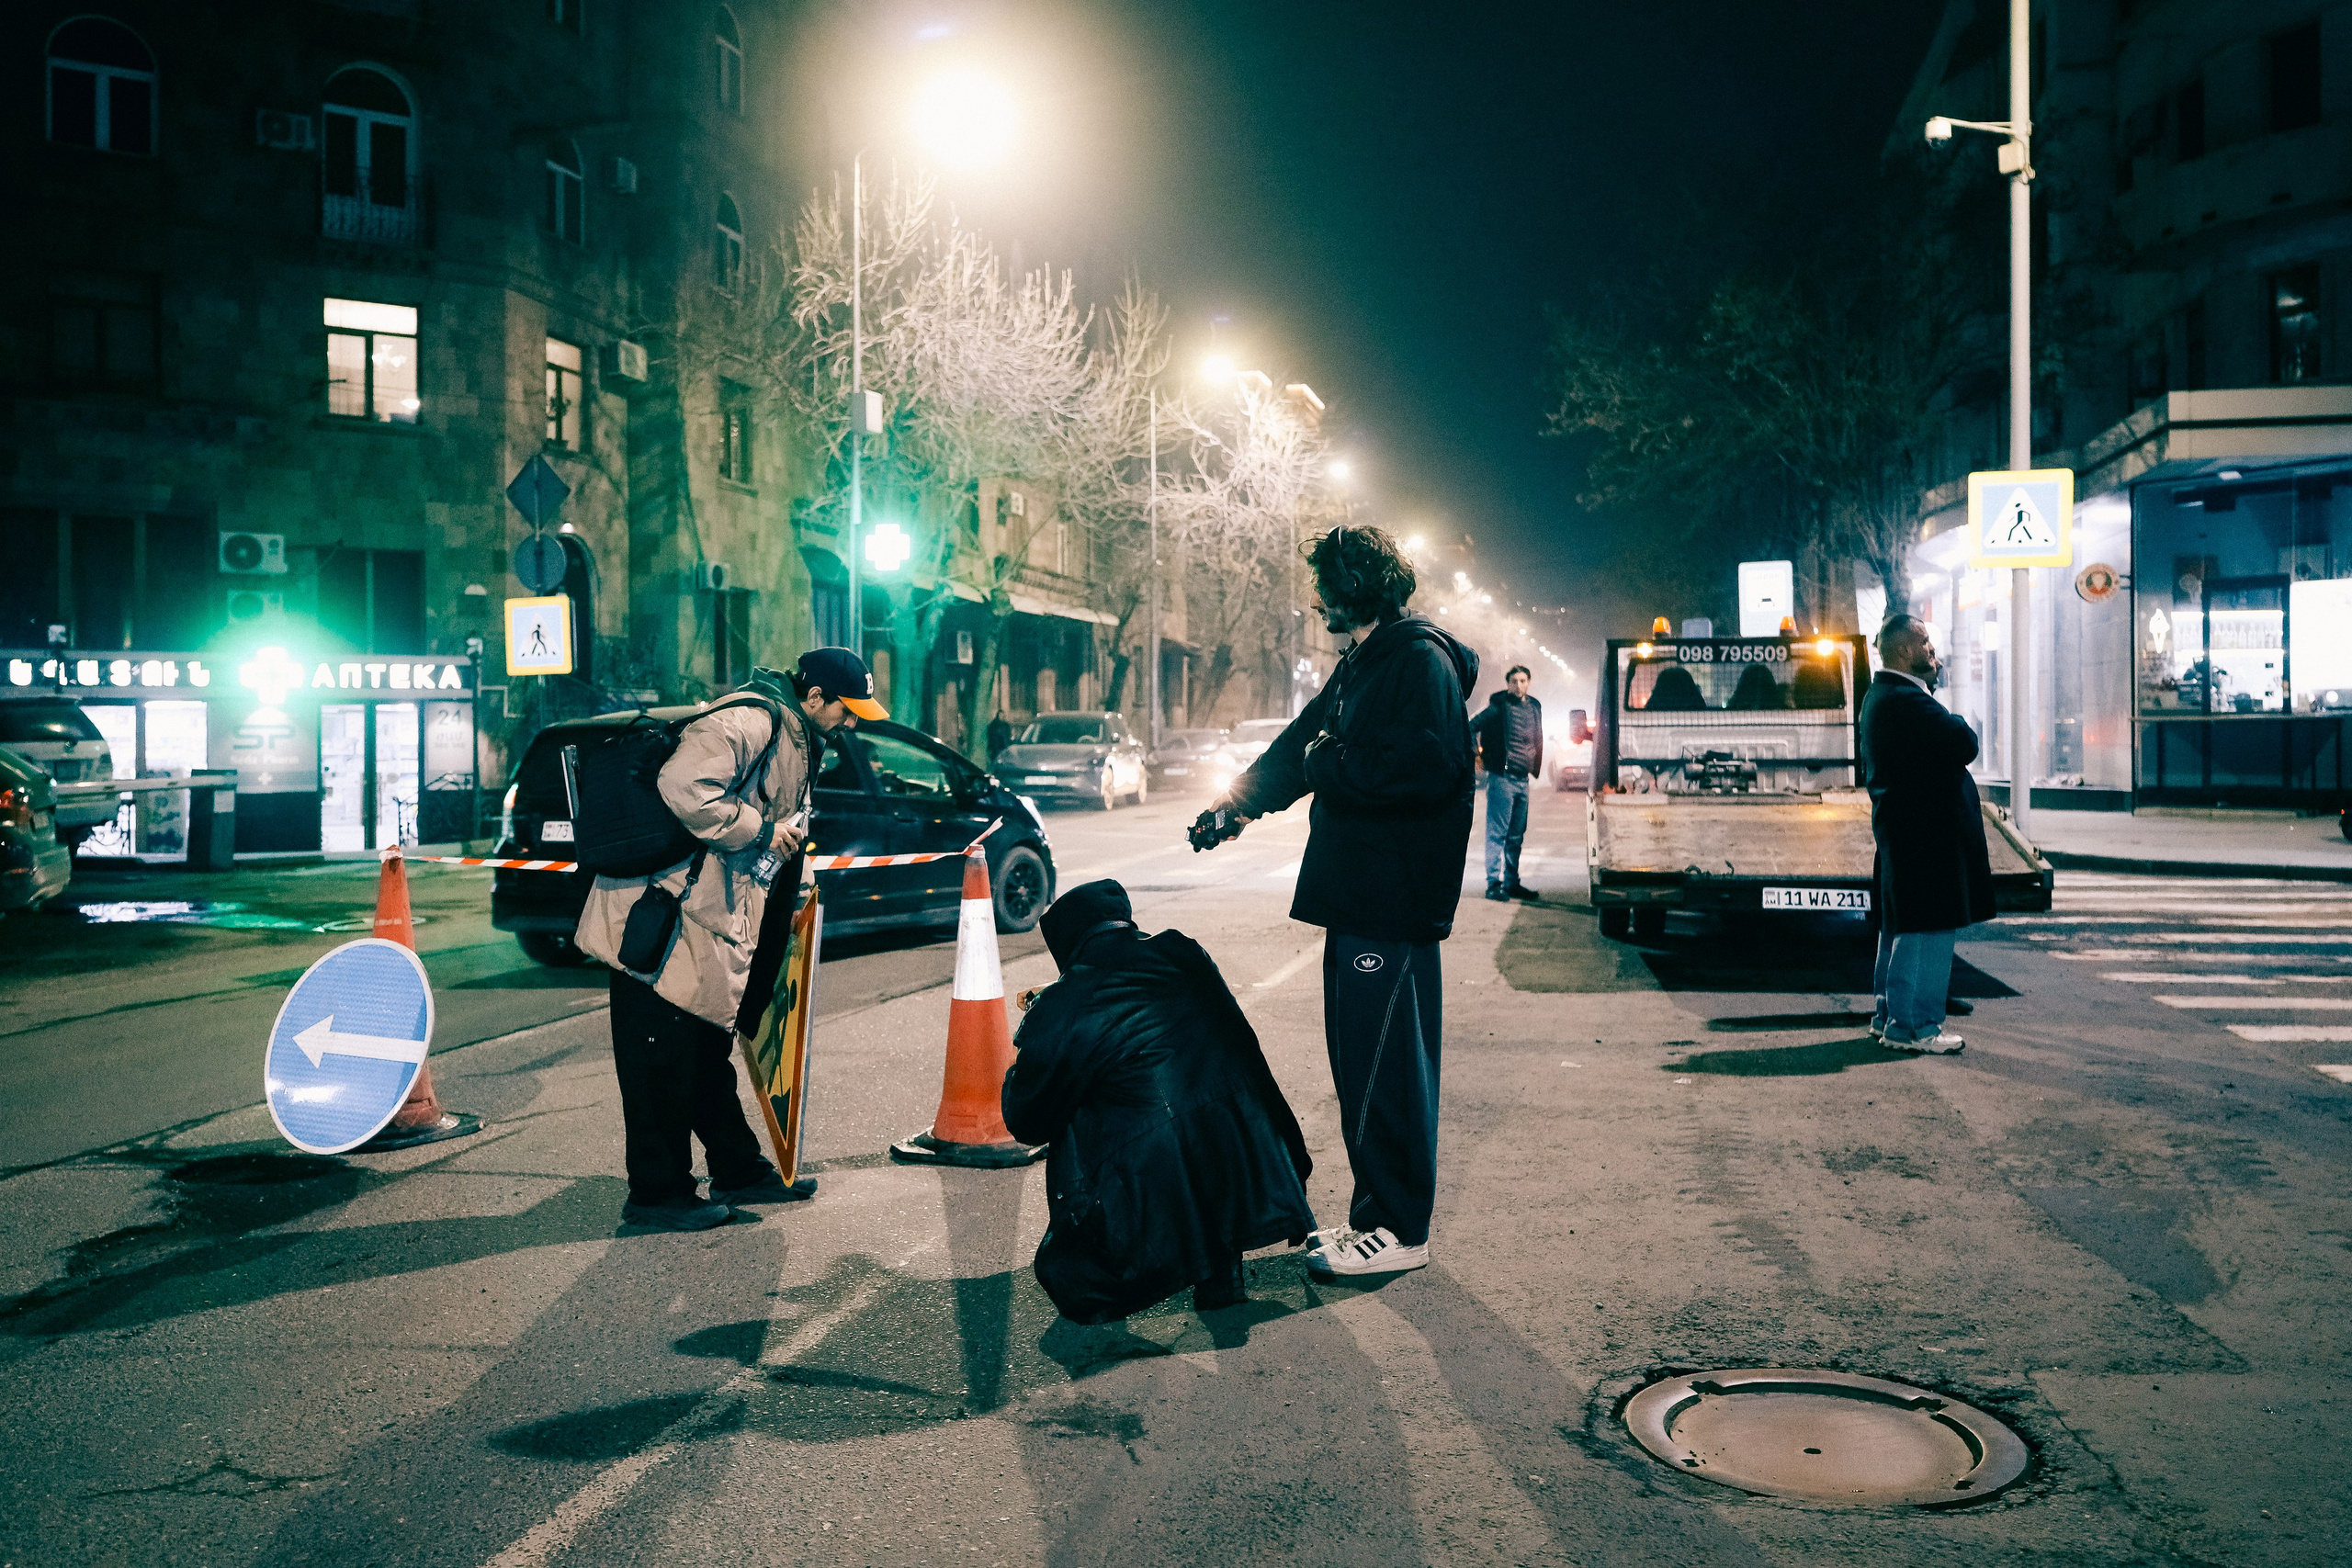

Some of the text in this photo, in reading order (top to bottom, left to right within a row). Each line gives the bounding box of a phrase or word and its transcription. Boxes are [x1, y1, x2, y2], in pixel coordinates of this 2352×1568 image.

[1679, 645, 1713, 662] 098
[311, 662, 462, 690] АПТЕКА
[437, 709, 462, 726] 24
[1784, 890, 1803, 906] 11
[1808, 891, 1831, 907] WA
[1837, 892, 1866, 908] 211
